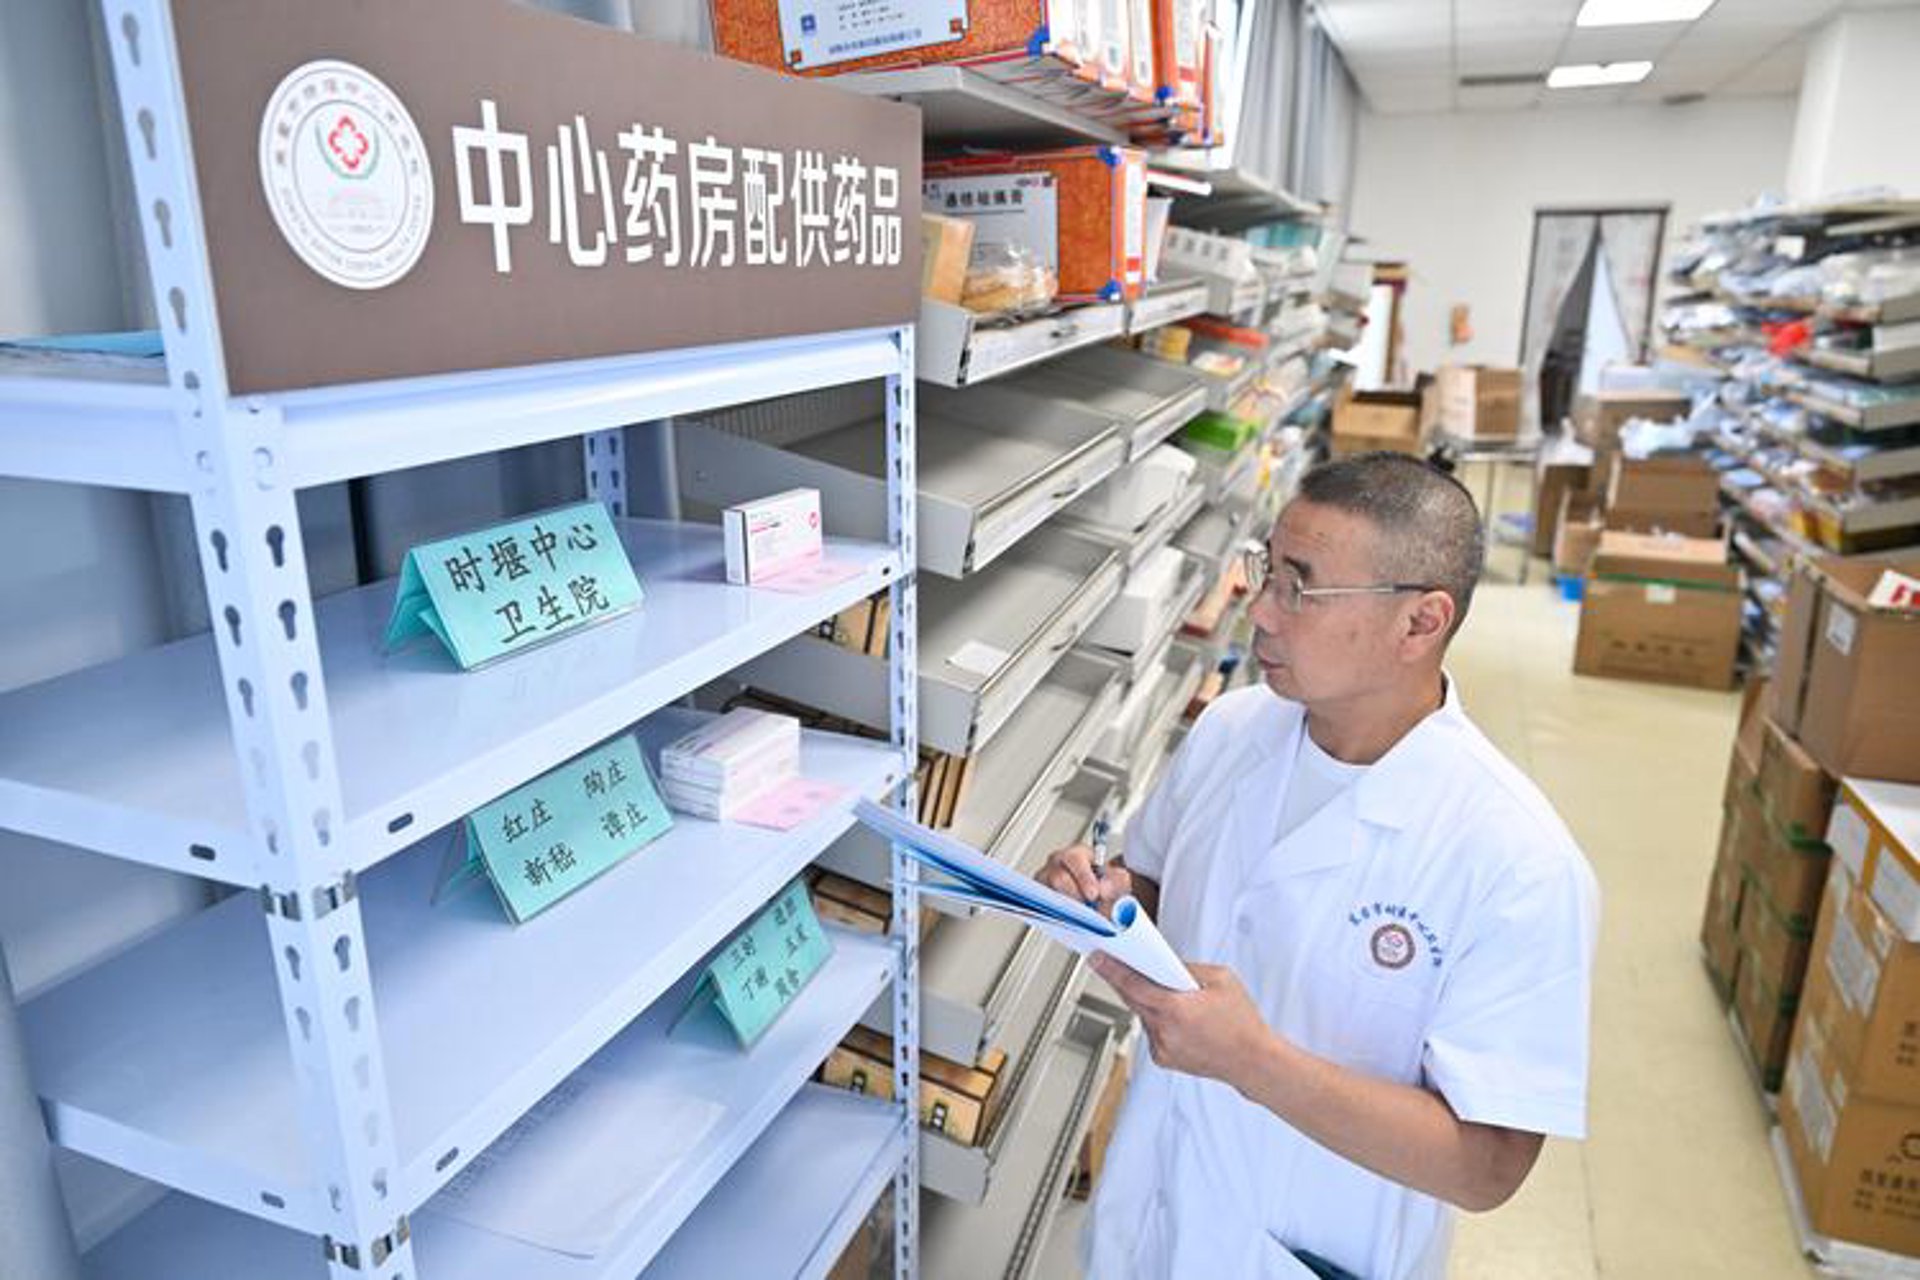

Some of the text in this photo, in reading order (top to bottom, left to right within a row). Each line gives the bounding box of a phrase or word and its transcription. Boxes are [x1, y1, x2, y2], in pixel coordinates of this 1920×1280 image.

[452, 99, 902, 273] 中心药房配供药品
[444, 522, 598, 594] 时堰中心
[494, 573, 611, 644] 卫生院
[502, 759, 627, 843] 红庄 陶庄
